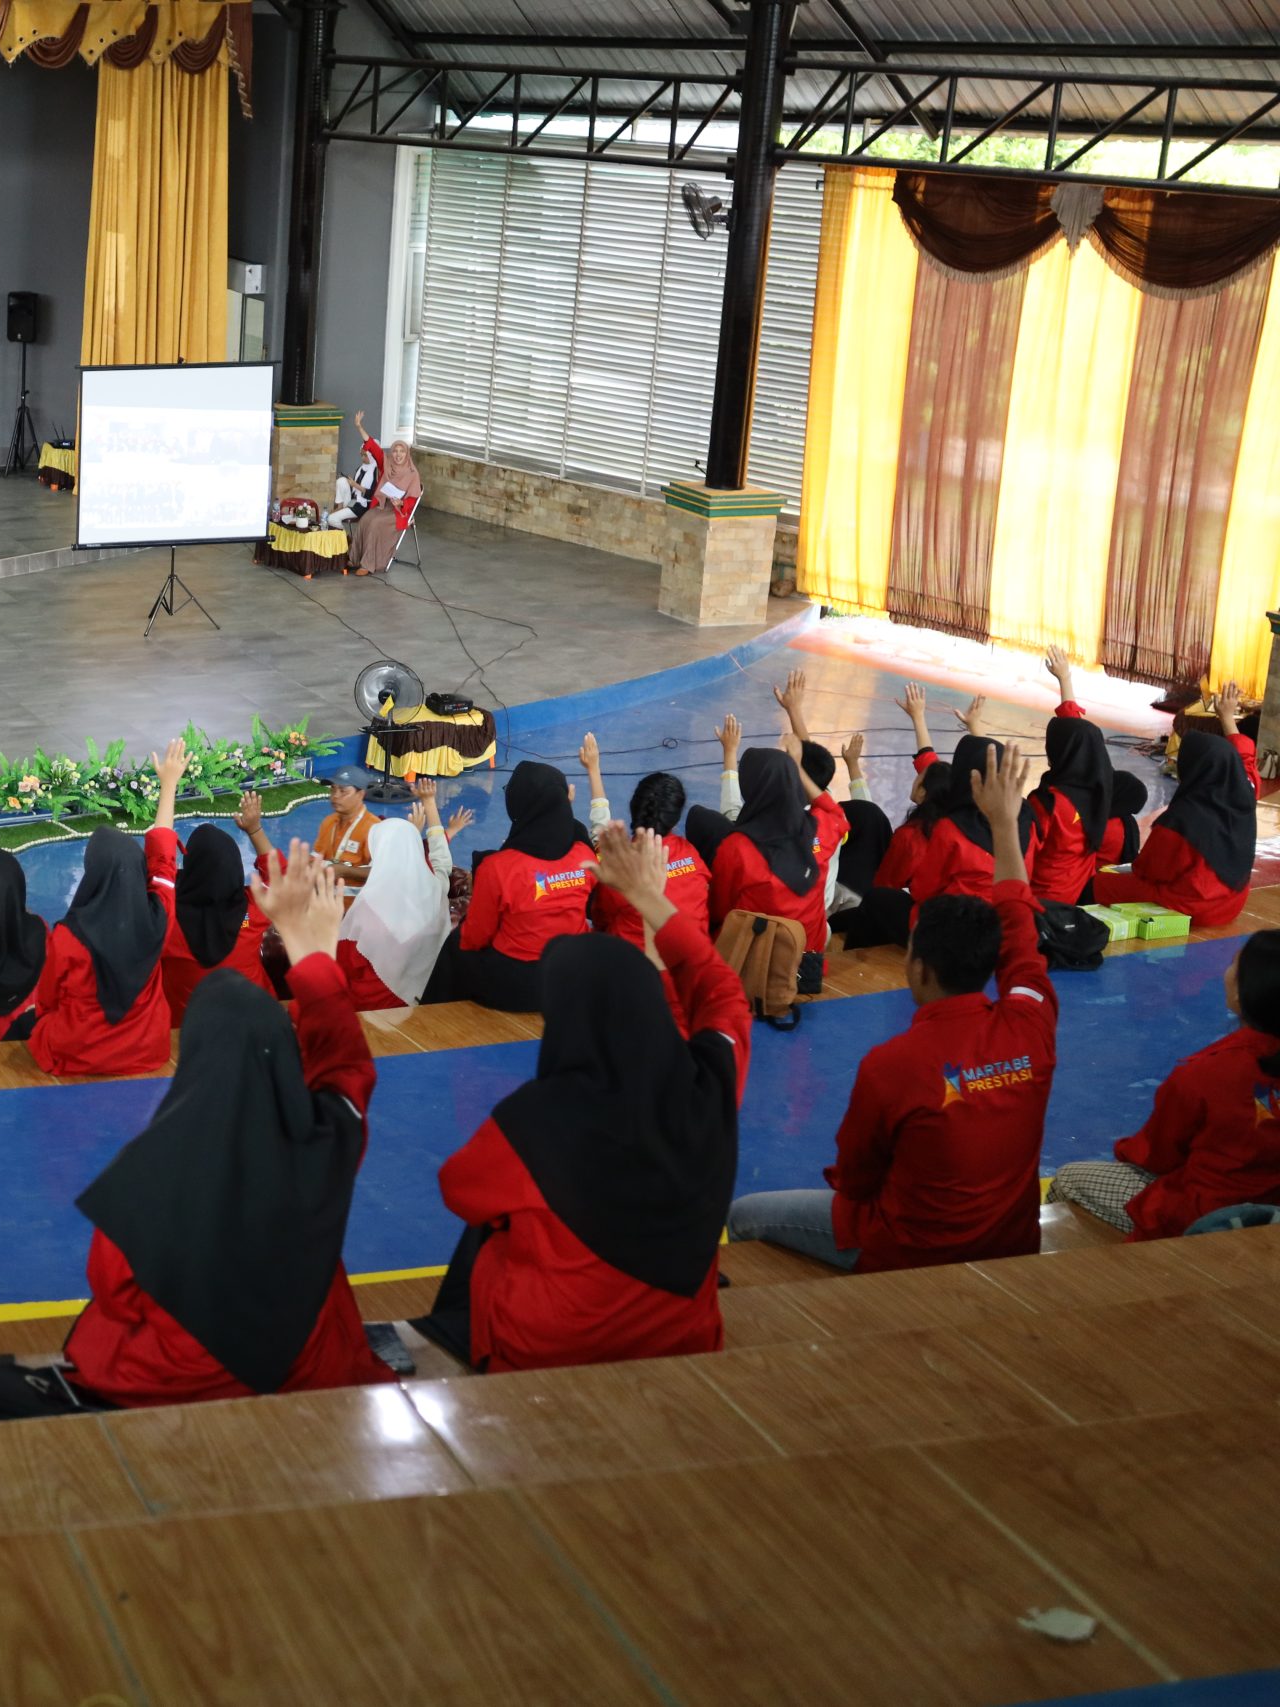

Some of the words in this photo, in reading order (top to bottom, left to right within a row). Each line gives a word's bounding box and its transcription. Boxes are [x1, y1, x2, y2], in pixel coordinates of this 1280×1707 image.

[666, 857, 695, 870] ARTABE
[547, 869, 586, 883] MARTABE
[666, 864, 697, 878] RESTASI
[550, 876, 586, 891] PRESTASI
[962, 1055, 1032, 1081] MARTABE
[967, 1068, 1033, 1093] PRESTASI
